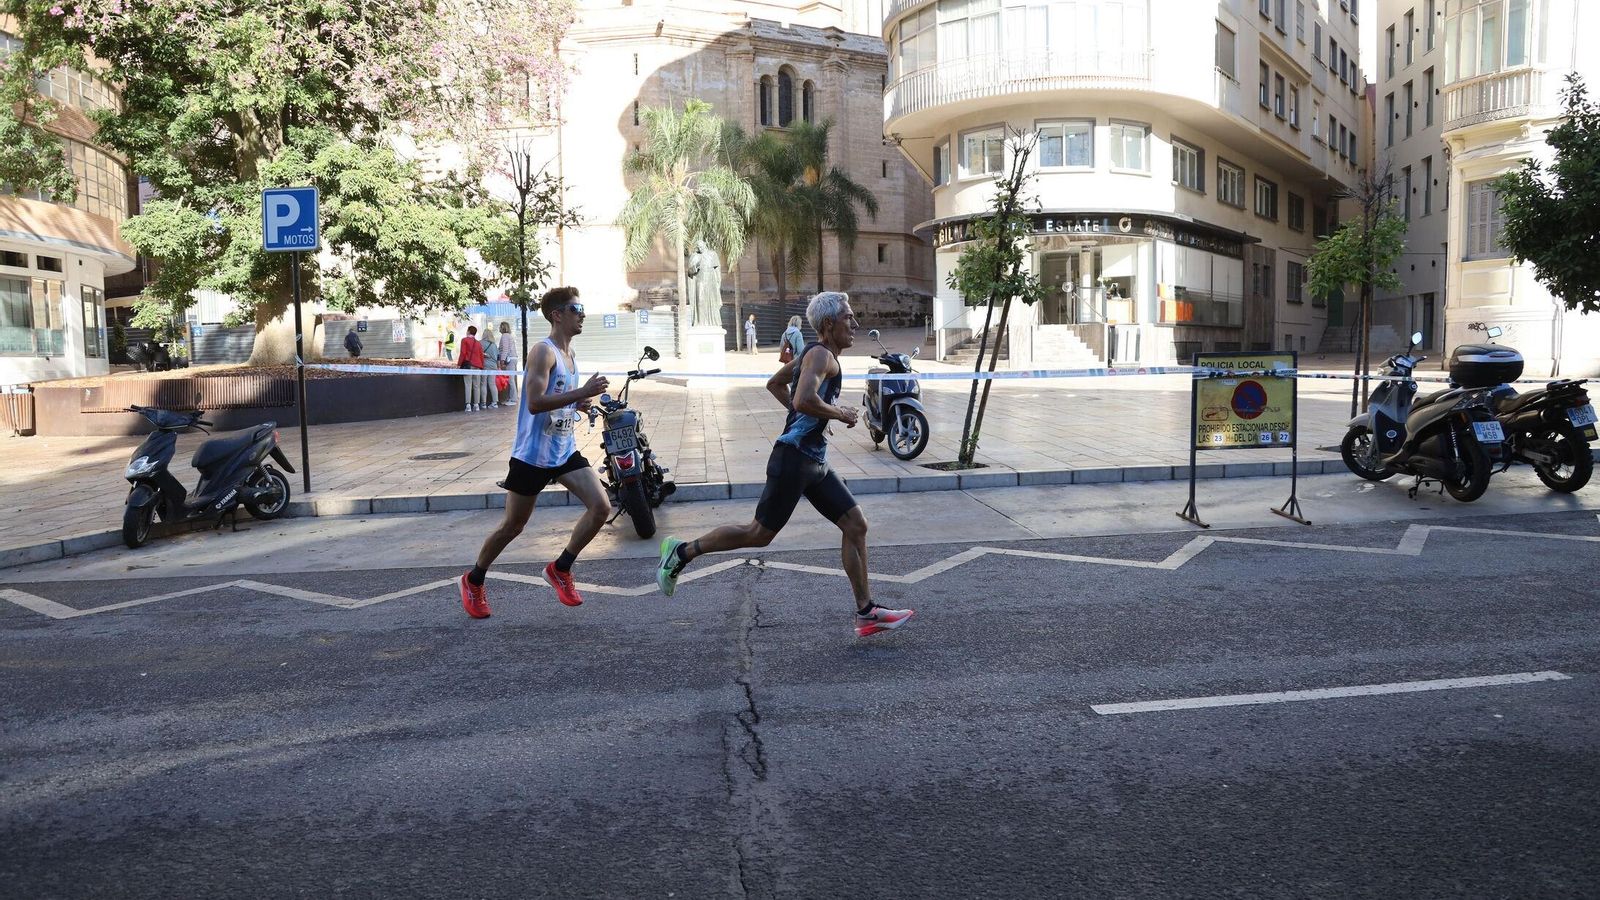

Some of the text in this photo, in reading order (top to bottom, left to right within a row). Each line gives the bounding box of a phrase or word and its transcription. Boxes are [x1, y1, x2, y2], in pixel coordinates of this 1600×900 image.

[266, 194, 300, 243] P
[1046, 220, 1100, 232] ESTATE
[283, 234, 314, 245] MOTOS
[1201, 360, 1266, 369] POLICIA LOCAL
[1198, 423, 1231, 433] PROHIBIDO
[1232, 422, 1269, 433] ESTACIONAR
[611, 427, 634, 441] 6492
[1198, 434, 1210, 443] LAS
[1234, 433, 1246, 442] DEL
[1280, 433, 1289, 441] 27
[615, 438, 633, 450] LCD
[220, 489, 237, 505] YAMAHA
